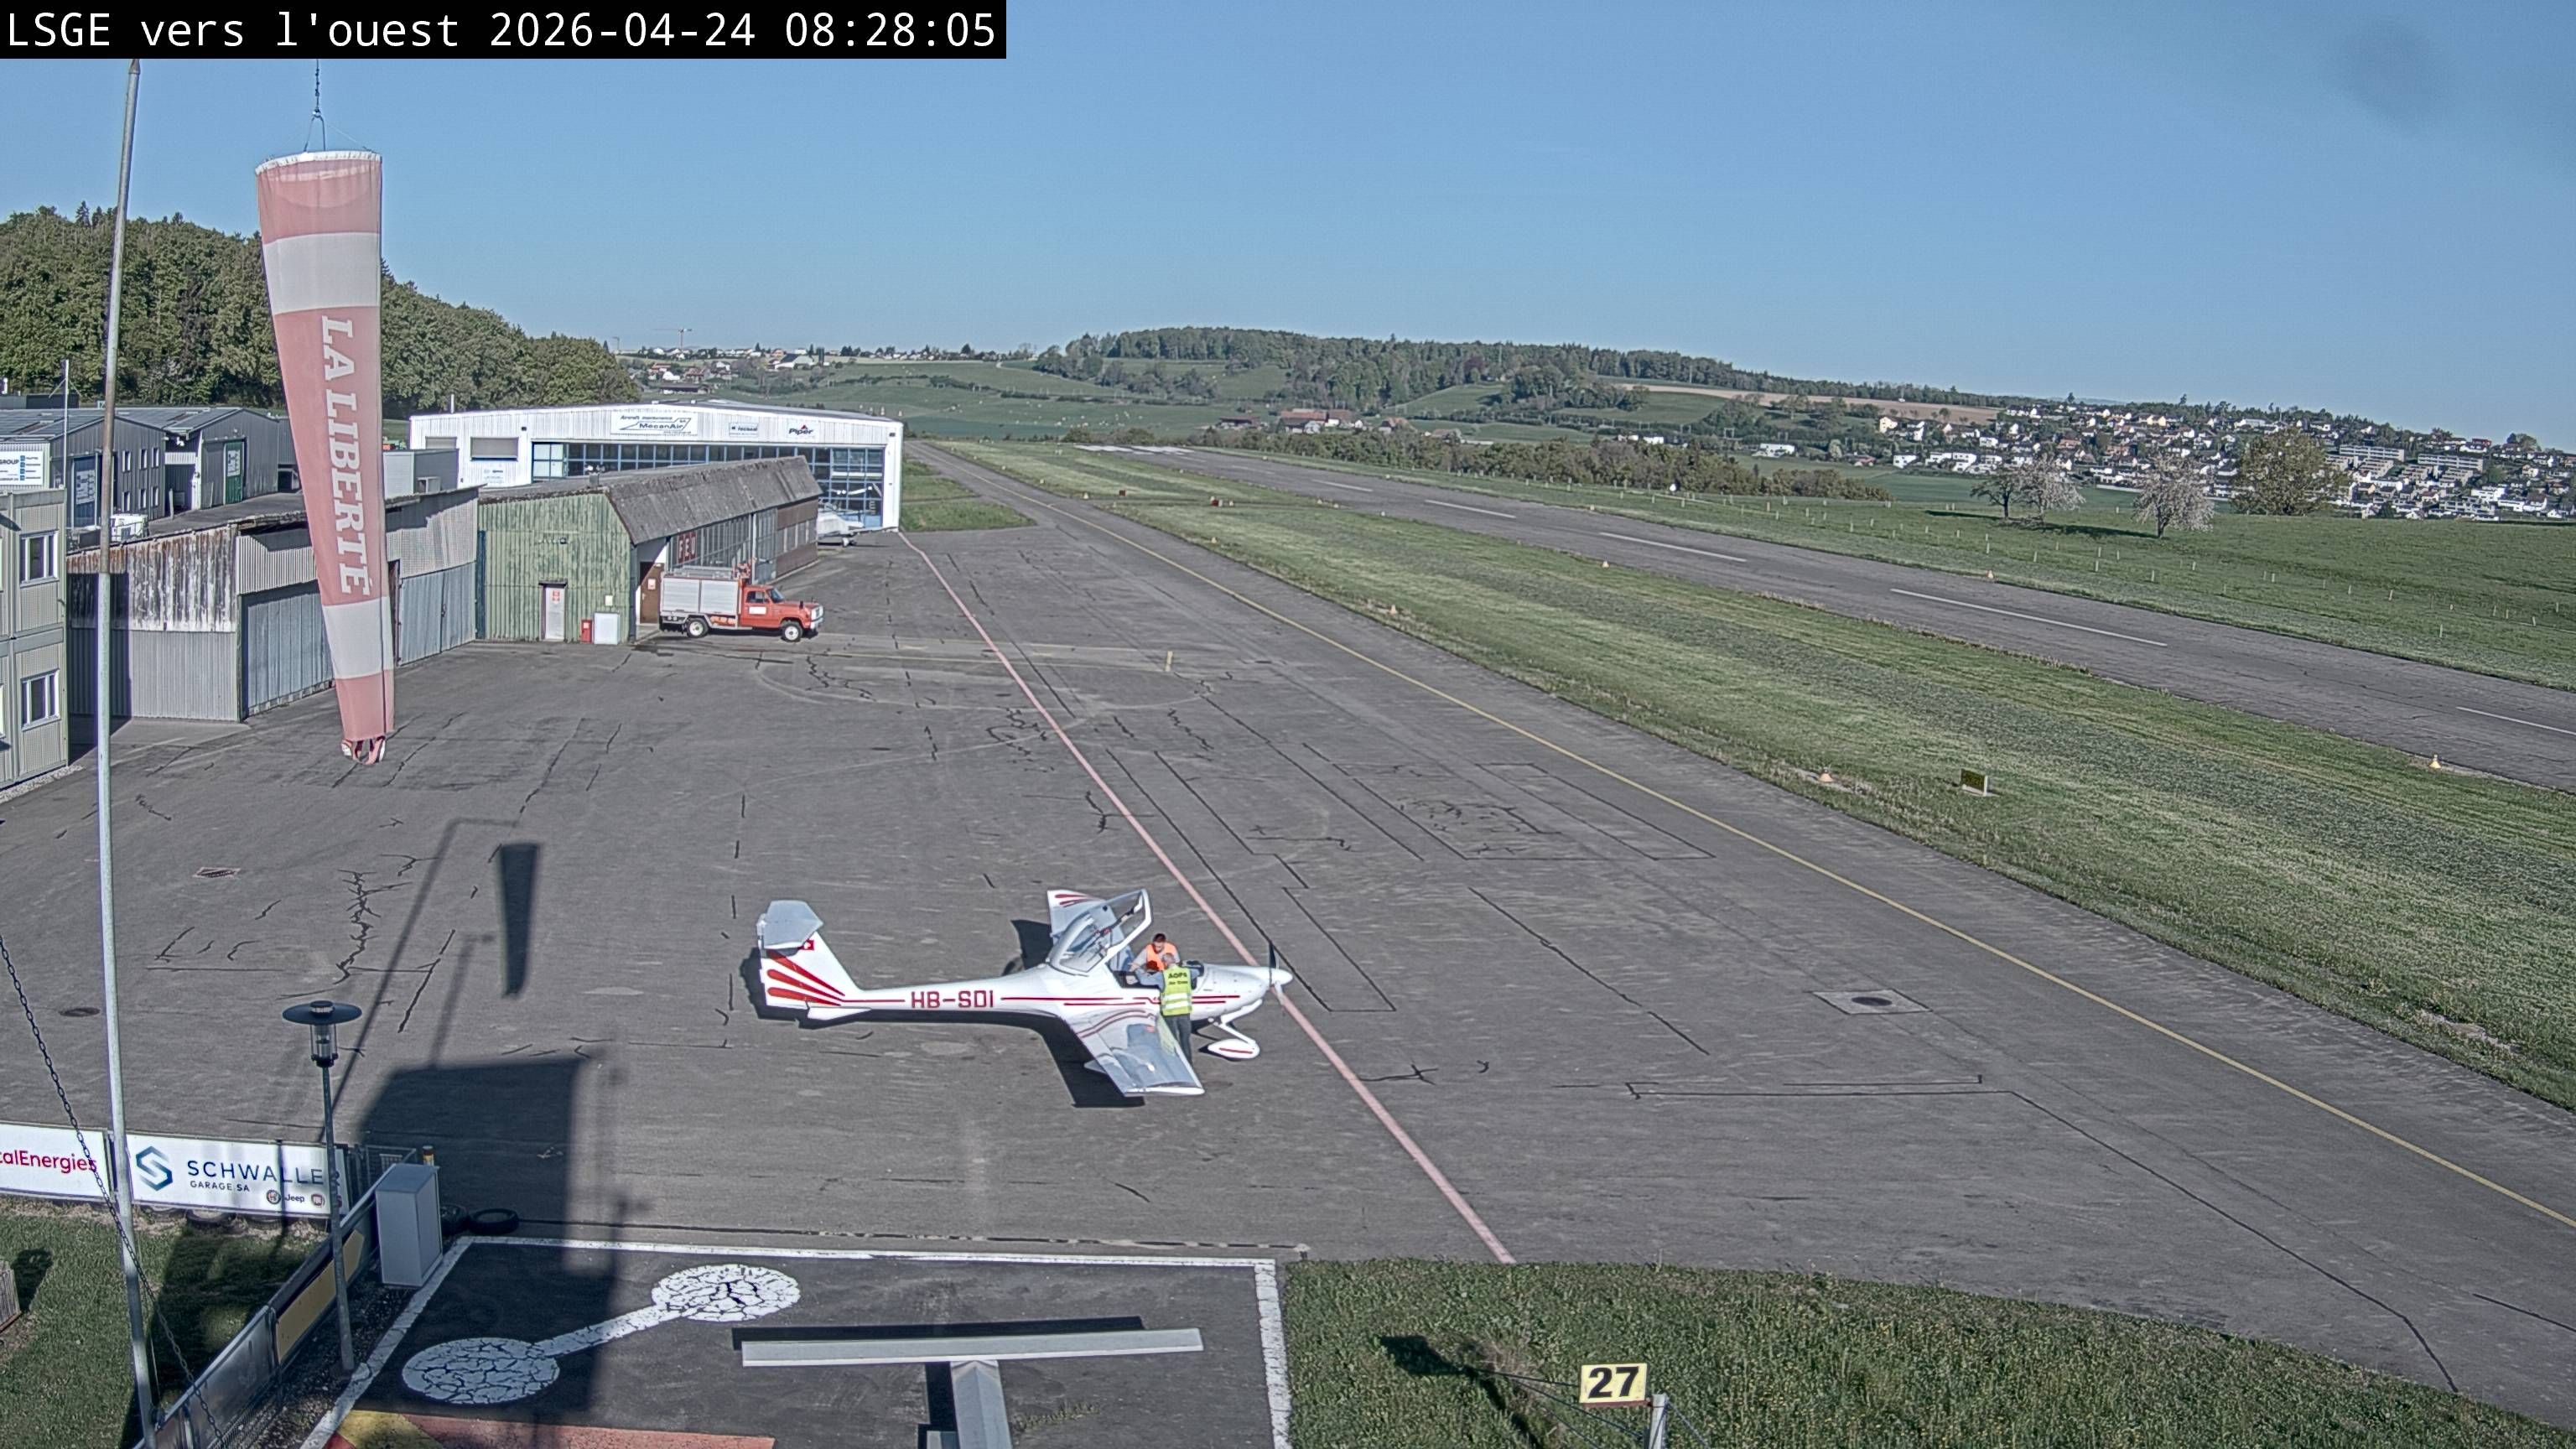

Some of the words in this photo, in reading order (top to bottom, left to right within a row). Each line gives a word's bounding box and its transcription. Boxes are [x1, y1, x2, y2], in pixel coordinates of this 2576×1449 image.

[322, 315, 355, 381] LA
[789, 427, 813, 435] Piper
[326, 388, 373, 596] LIBERTÉ
[678, 537, 696, 559] FEU
[190, 1180, 233, 1191] GARAGE
[236, 1183, 251, 1192] SA
[284, 1193, 305, 1203] Jeep
[1587, 1366, 1639, 1399] 27
